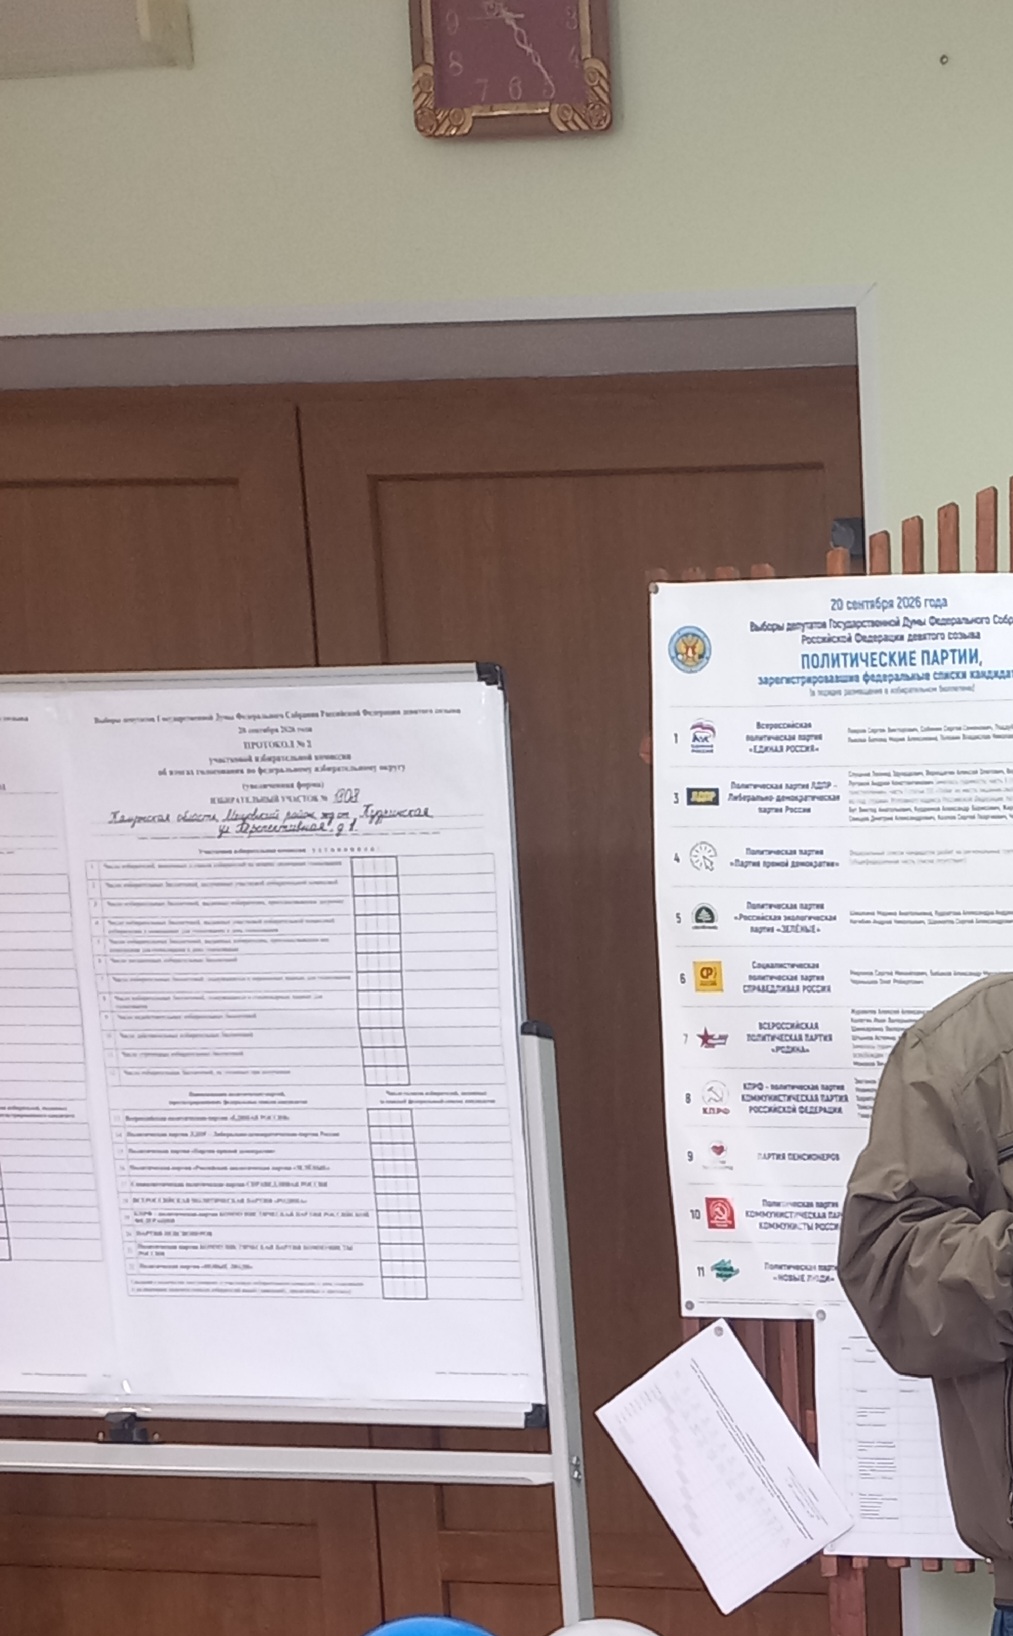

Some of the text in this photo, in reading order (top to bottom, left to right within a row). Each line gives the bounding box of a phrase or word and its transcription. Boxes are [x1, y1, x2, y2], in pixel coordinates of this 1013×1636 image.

[476, 78, 488, 101] 7
[509, 76, 522, 100] 6
[830, 596, 948, 612] 20 сентября 2026 года
[750, 621, 784, 633] Выборы
[829, 617, 900, 631] Государственной
[902, 616, 926, 629] Думы
[929, 616, 990, 627] Федерального
[801, 631, 981, 644] Российской Федерации девятого созыва
[801, 648, 983, 669] ПОЛИТИЧЕСКИЕ ПАРТИИ,
[862, 672, 930, 685] федеральные
[674, 733, 679, 744] 1
[244, 740, 295, 749] ПРОТОКОЛ
[674, 792, 680, 804] 3
[674, 853, 680, 864] 4
[676, 913, 682, 924] 5
[680, 973, 686, 984] 6
[686, 1093, 692, 1104] 8
[688, 1151, 694, 1162] 9
[690, 1209, 701, 1220] 10
[697, 1266, 705, 1277] 11
